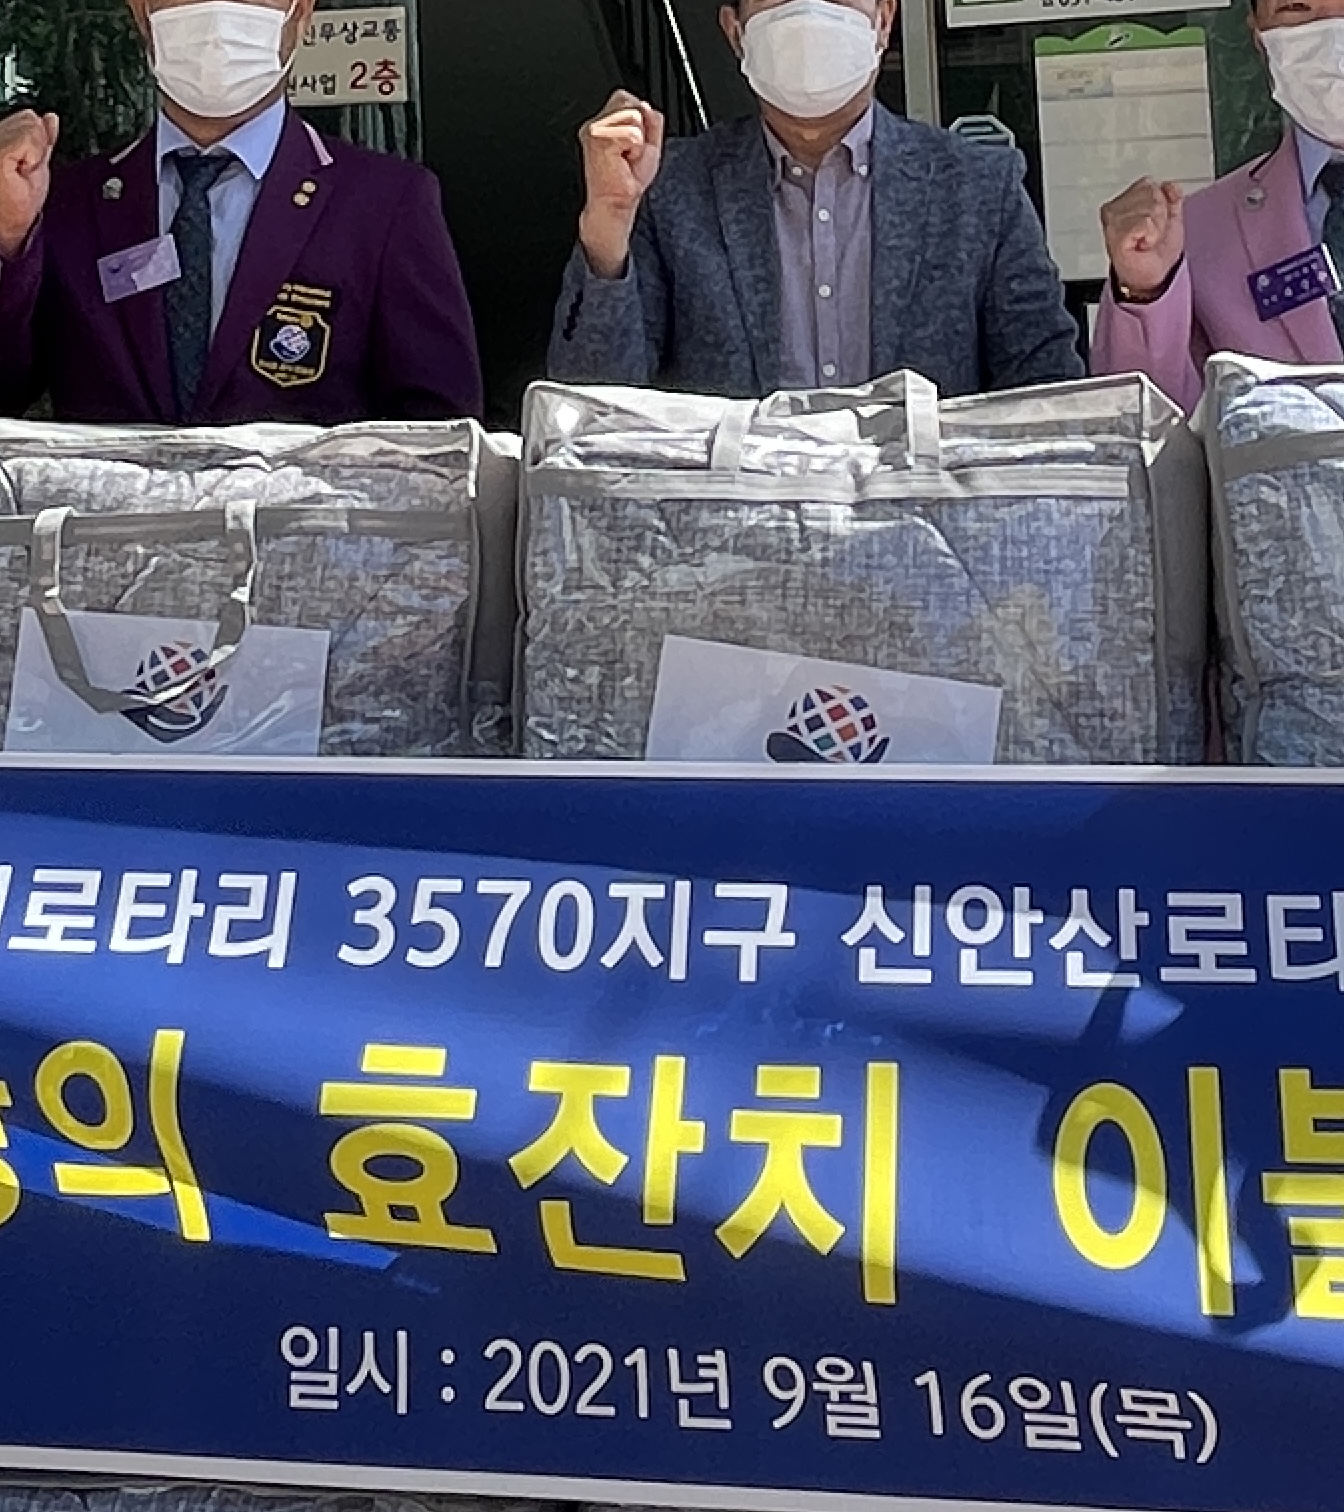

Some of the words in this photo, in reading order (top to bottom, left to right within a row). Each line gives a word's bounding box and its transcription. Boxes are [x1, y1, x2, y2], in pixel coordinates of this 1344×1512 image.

[349, 58, 402, 96] 2층
[336, 874, 798, 983] 3570지구
[318, 1042, 899, 1304] 효잔치
[279, 1324, 410, 1415] 일시
[481, 1338, 735, 1432] 2021년
[761, 1355, 884, 1440] 9월
[912, 1369, 1220, 1465] 16일(목)
